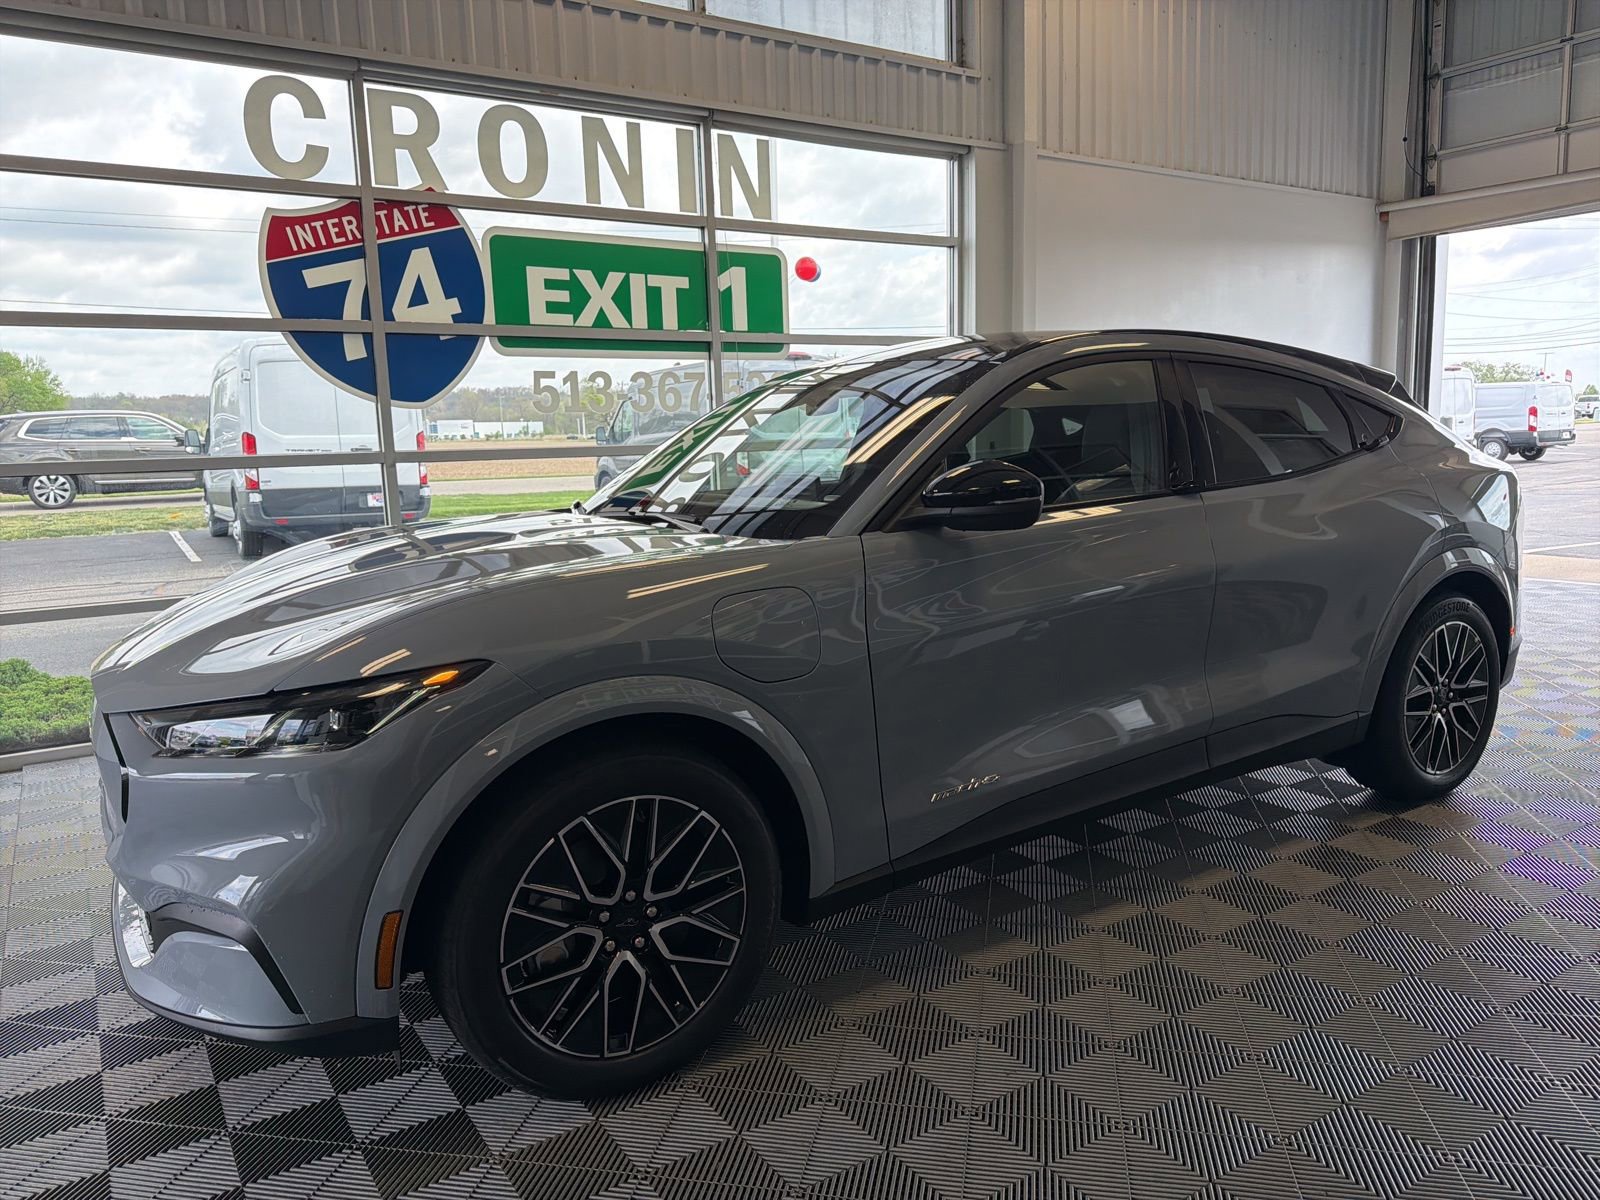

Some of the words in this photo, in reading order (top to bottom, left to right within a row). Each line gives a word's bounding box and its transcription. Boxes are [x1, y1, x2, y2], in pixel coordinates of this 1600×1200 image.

[243, 74, 772, 220] CRONIN
[286, 204, 435, 252] INTERTATE
[301, 246, 463, 362] 74
[525, 265, 690, 331] EXIT
[716, 266, 749, 332] 1
